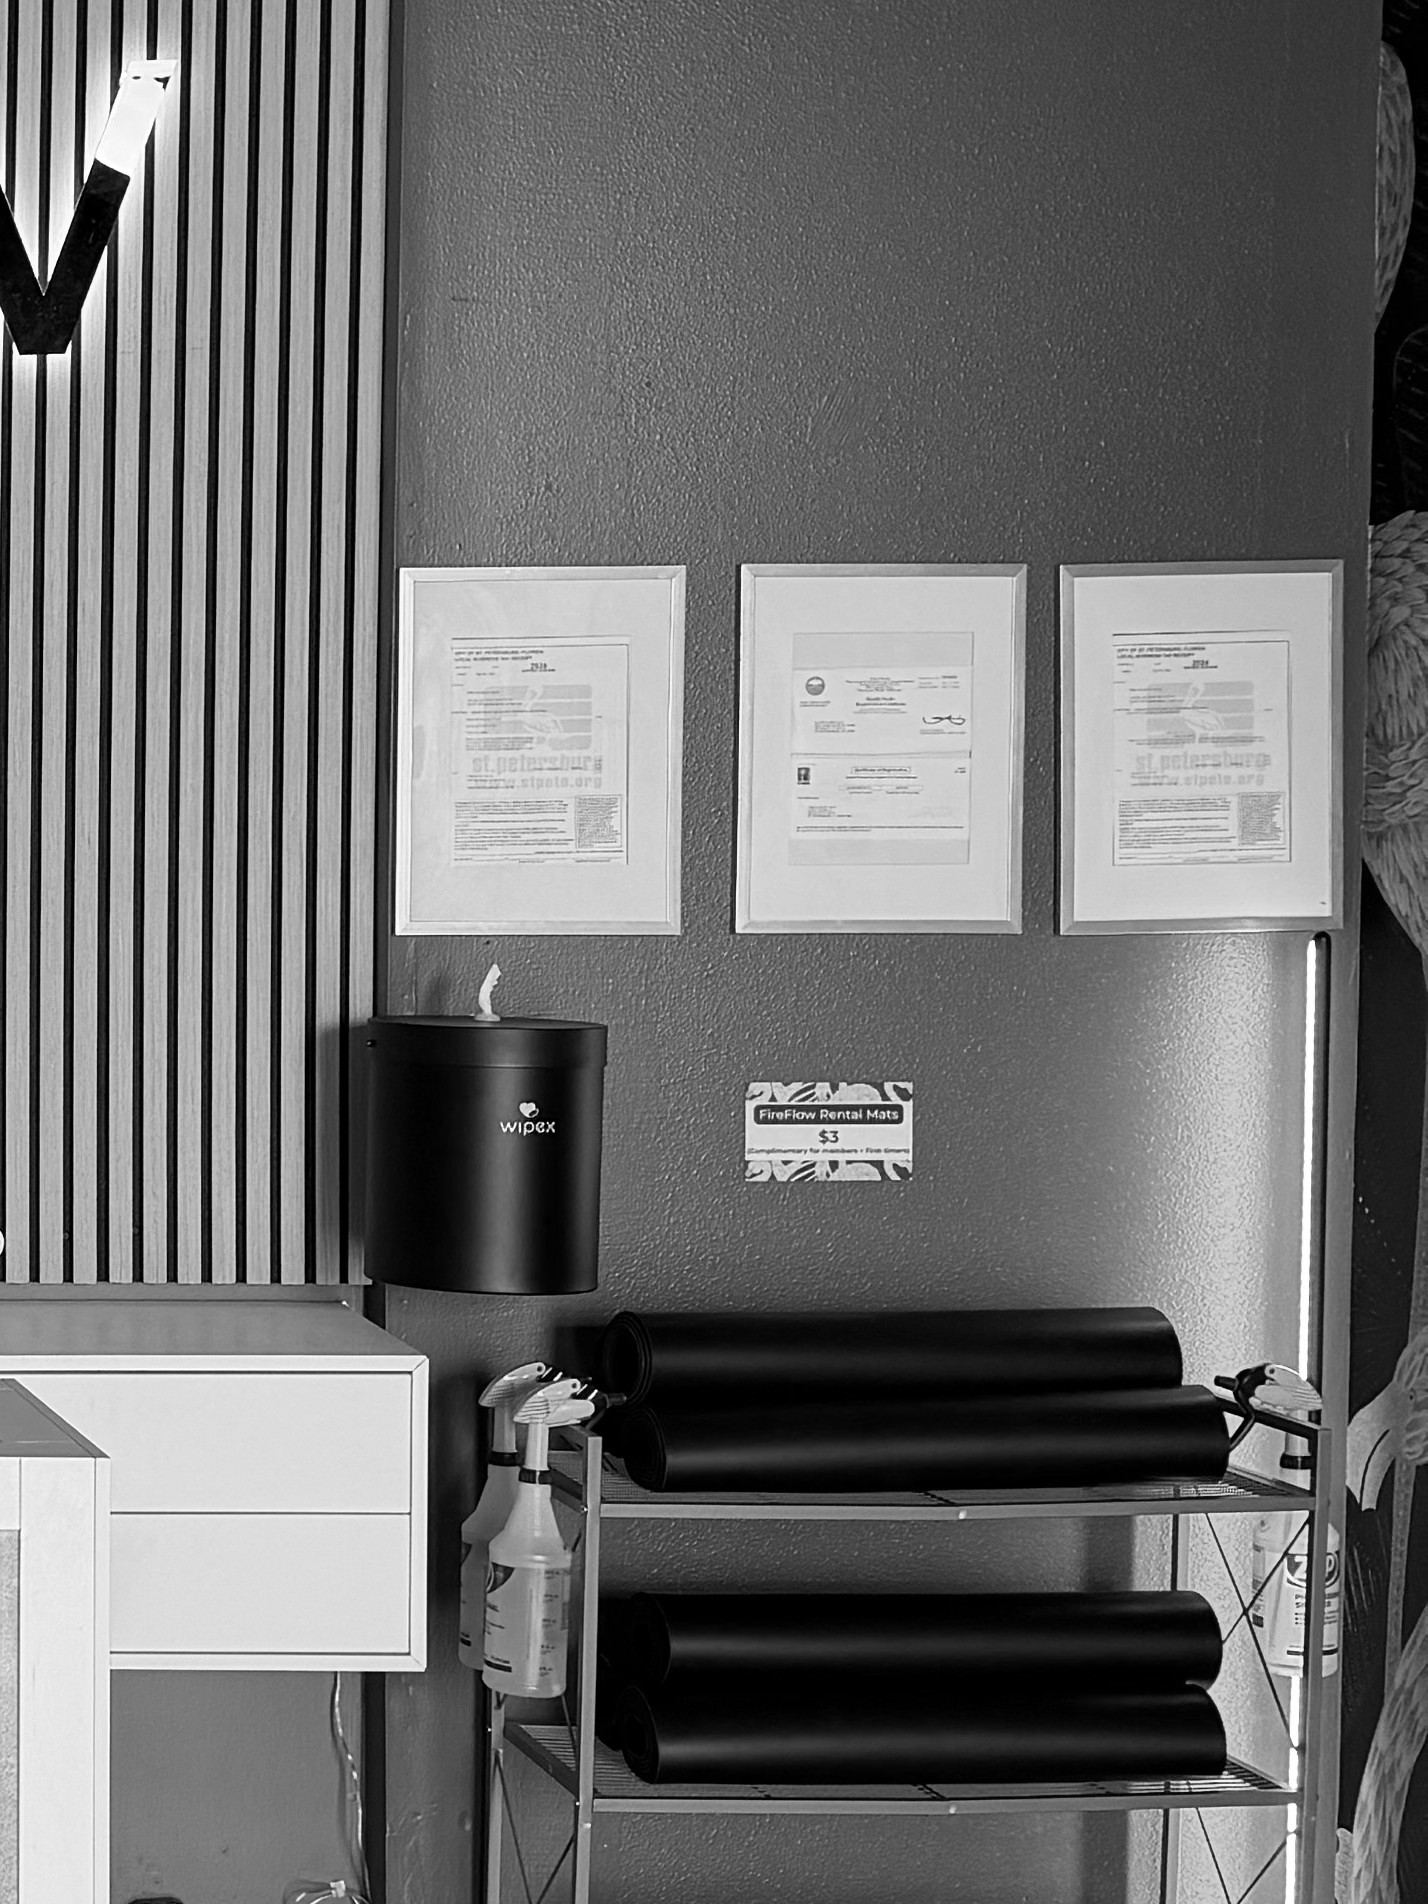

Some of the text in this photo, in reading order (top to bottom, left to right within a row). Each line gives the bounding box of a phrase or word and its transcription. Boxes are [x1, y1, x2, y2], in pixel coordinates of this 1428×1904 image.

[760, 1109, 899, 1120] FireFlow Rental Mats
[500, 1119, 556, 1136] wipex
[818, 1129, 839, 1144] $3
